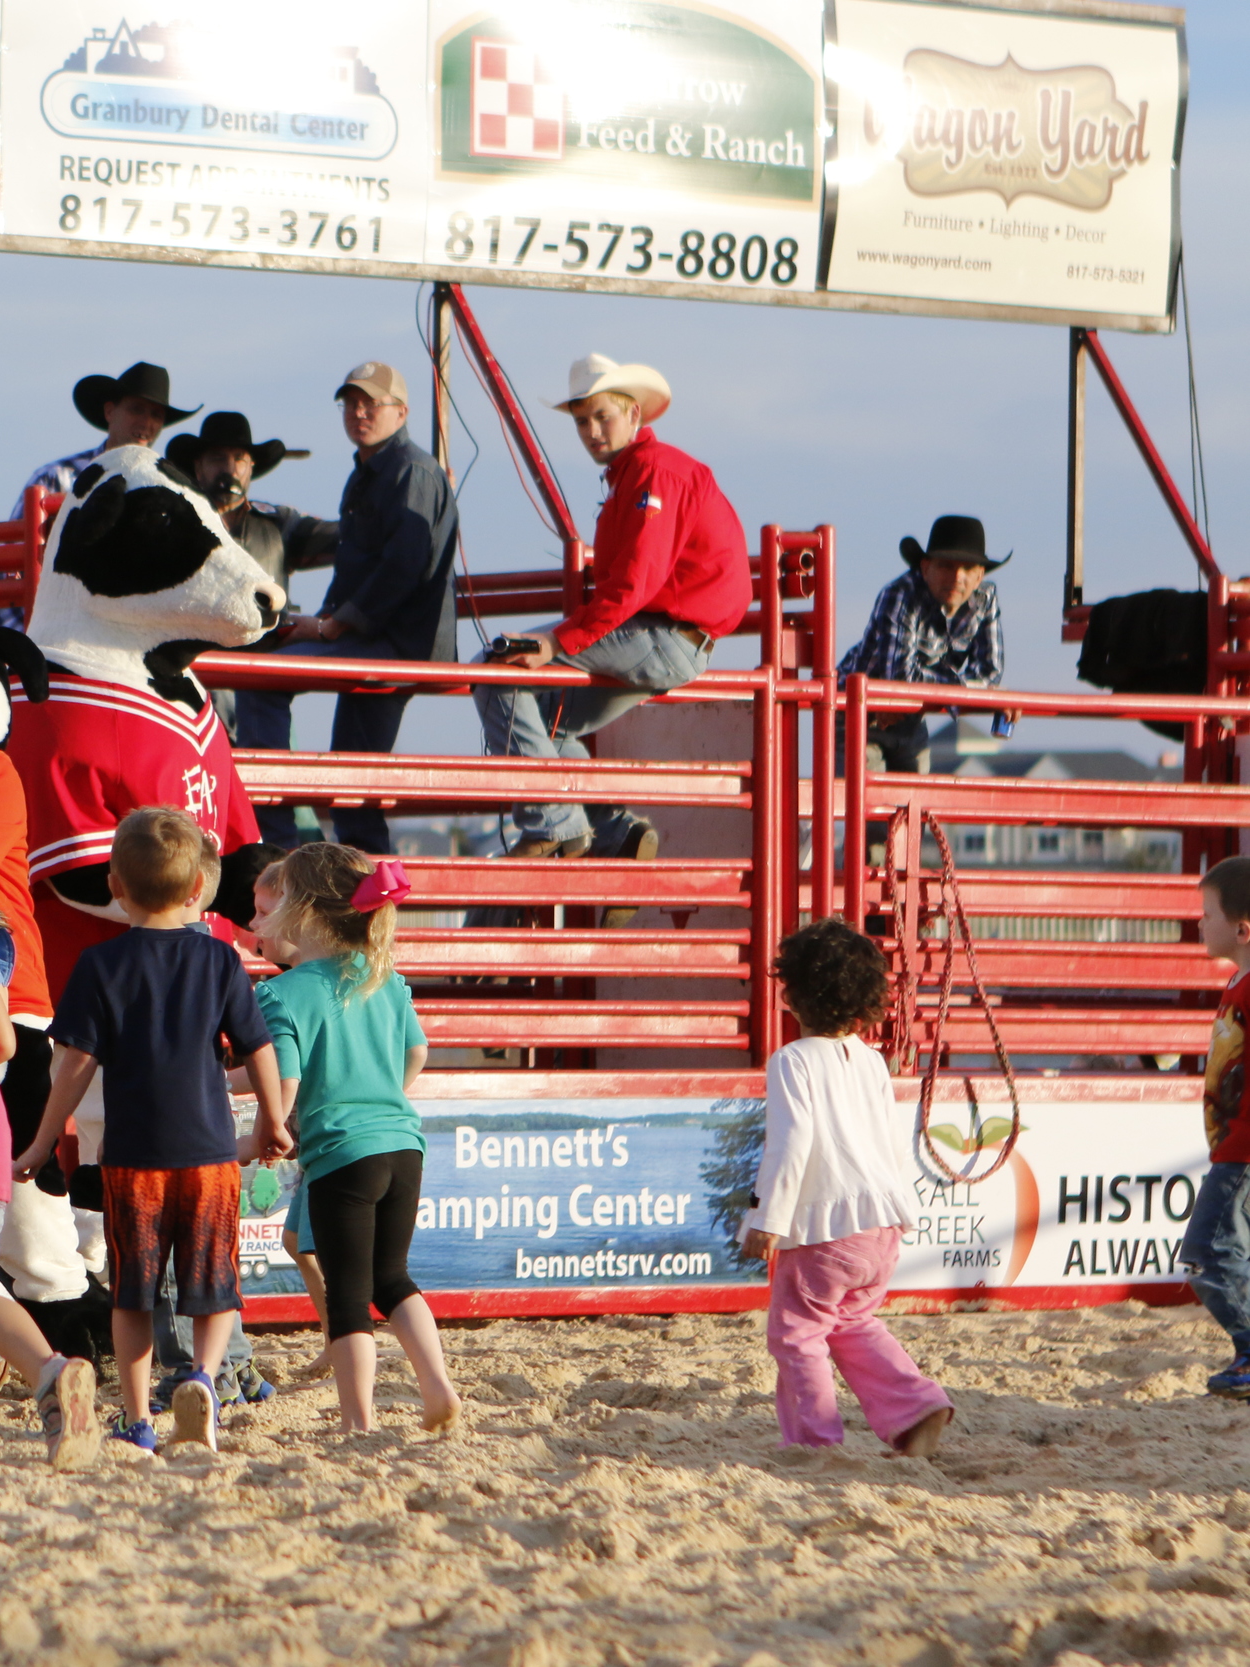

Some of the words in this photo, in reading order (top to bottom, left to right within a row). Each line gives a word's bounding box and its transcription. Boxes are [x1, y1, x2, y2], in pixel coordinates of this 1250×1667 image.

[70, 93, 190, 133] Granbury
[201, 103, 280, 135] Dental
[290, 112, 370, 141] Center
[1040, 89, 1150, 177] Yard
[577, 118, 657, 155] Feed
[665, 123, 693, 158] &
[701, 124, 806, 168] Ranch
[60, 155, 181, 187] REQUEST
[59, 194, 383, 253] 817-573-3761
[902, 210, 974, 233] Furniture
[989, 217, 1050, 241] Lighting
[1065, 224, 1107, 245] Decor
[444, 210, 800, 286] 817-573-8808
[856, 249, 992, 272] www.wagonyard.com
[1066, 264, 1145, 285] 817-573-5321
[455, 1126, 630, 1169] Bennett's
[913, 1174, 980, 1208] FALL
[1057, 1174, 1207, 1225] HISTO
[416, 1184, 559, 1240] amping
[568, 1184, 692, 1227] Center
[515, 1248, 712, 1279] bennettsrv.com
[942, 1248, 1002, 1269] FARMS
[1062, 1238, 1190, 1278] ALWAY
